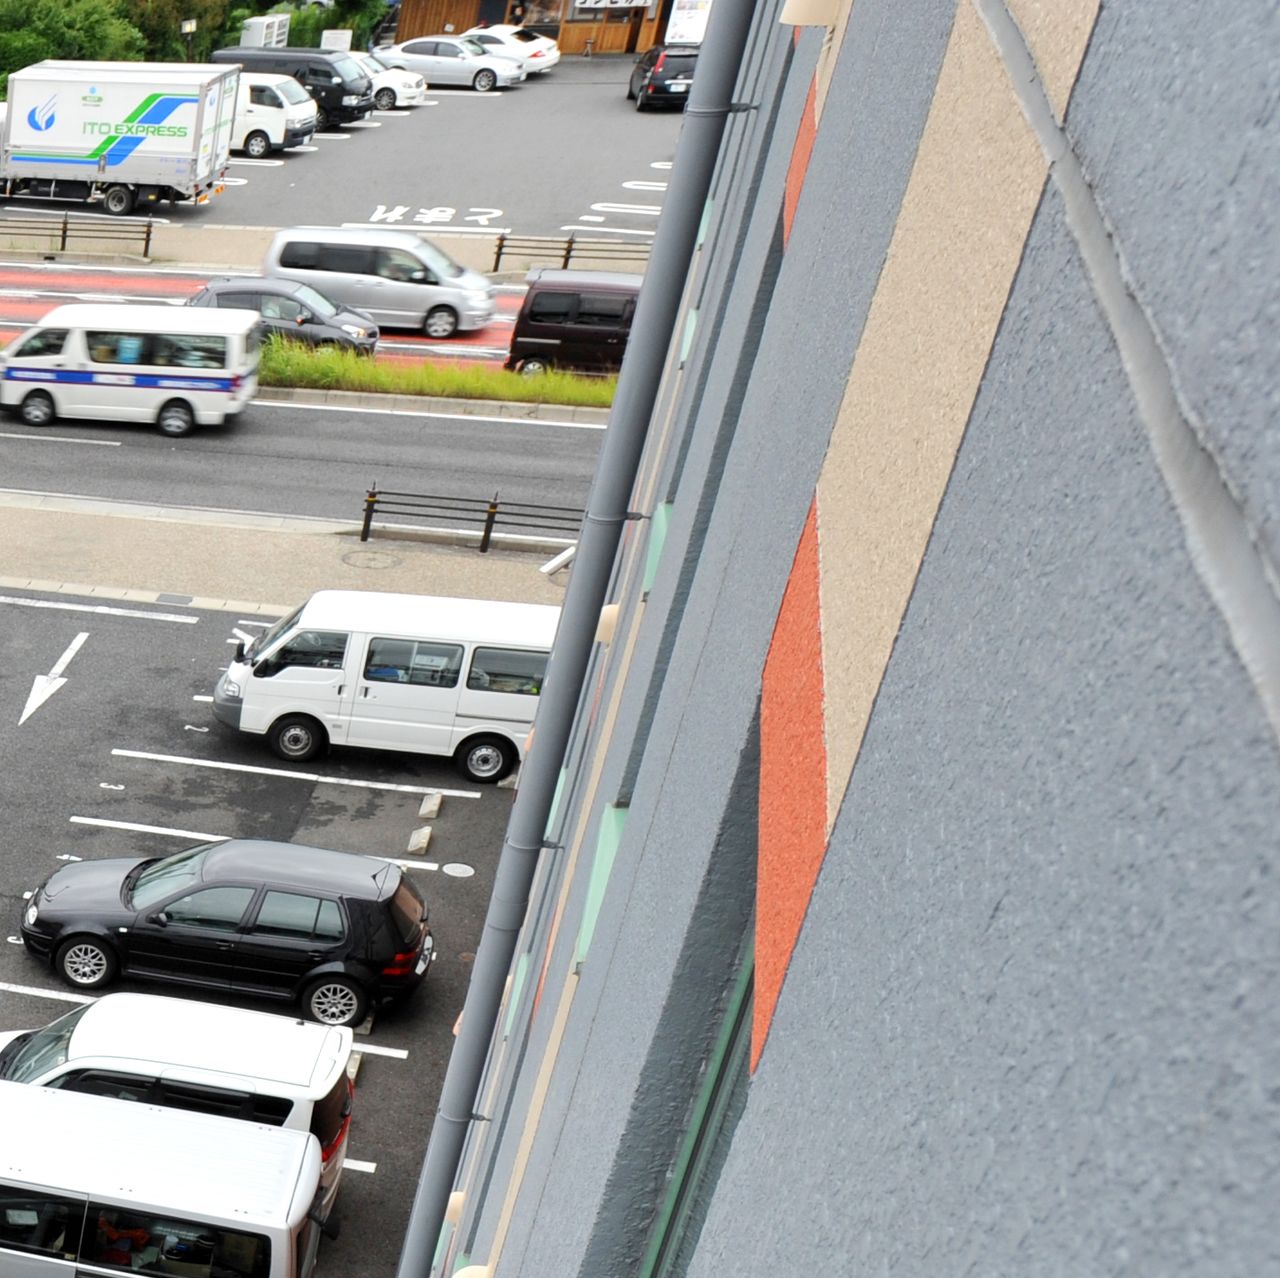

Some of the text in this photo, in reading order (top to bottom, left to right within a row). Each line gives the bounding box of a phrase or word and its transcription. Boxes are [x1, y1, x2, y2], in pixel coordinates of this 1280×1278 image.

[83, 121, 111, 135] ITO
[114, 124, 188, 138] EXPRESS
[183, 724, 209, 733] 2
[99, 782, 125, 791] 3
